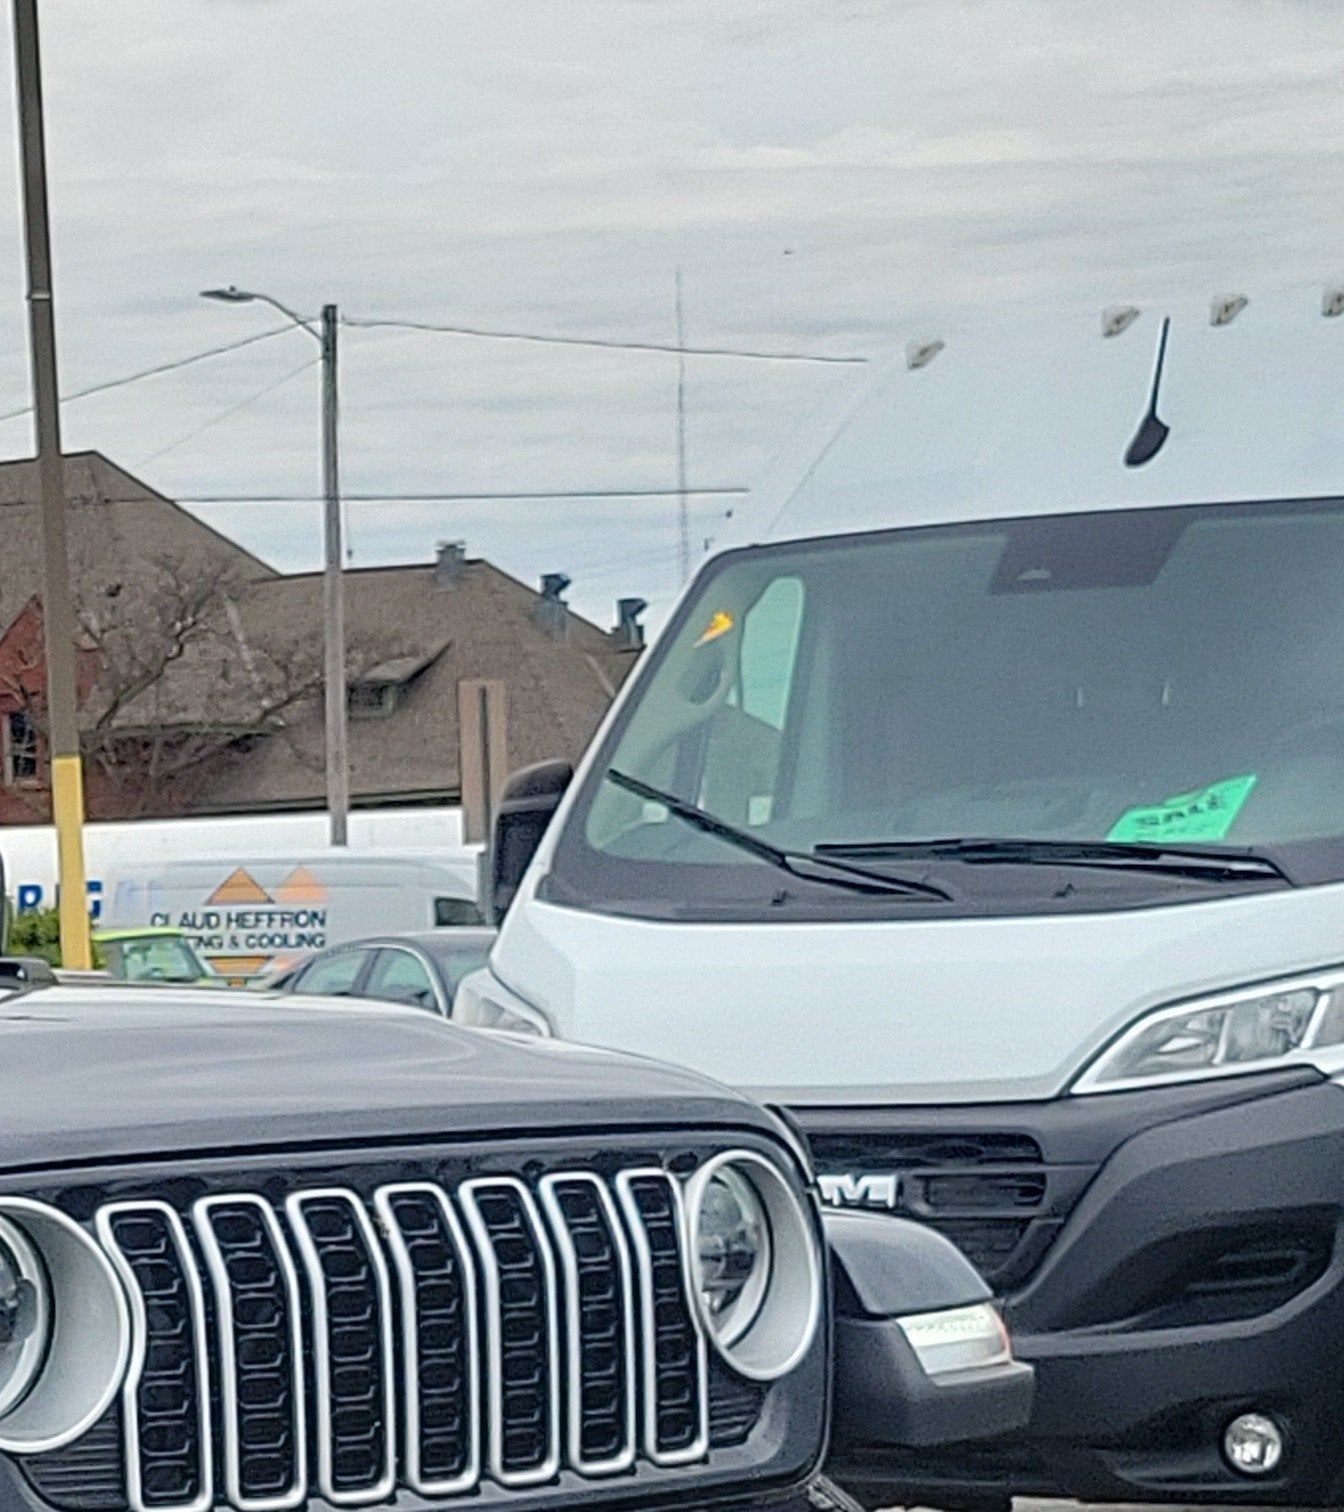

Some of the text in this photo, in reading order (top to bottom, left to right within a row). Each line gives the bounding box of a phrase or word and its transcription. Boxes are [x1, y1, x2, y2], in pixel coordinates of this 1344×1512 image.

[150, 910, 327, 930] CLAUD HEFFRON
[244, 932, 326, 949] COOLING
